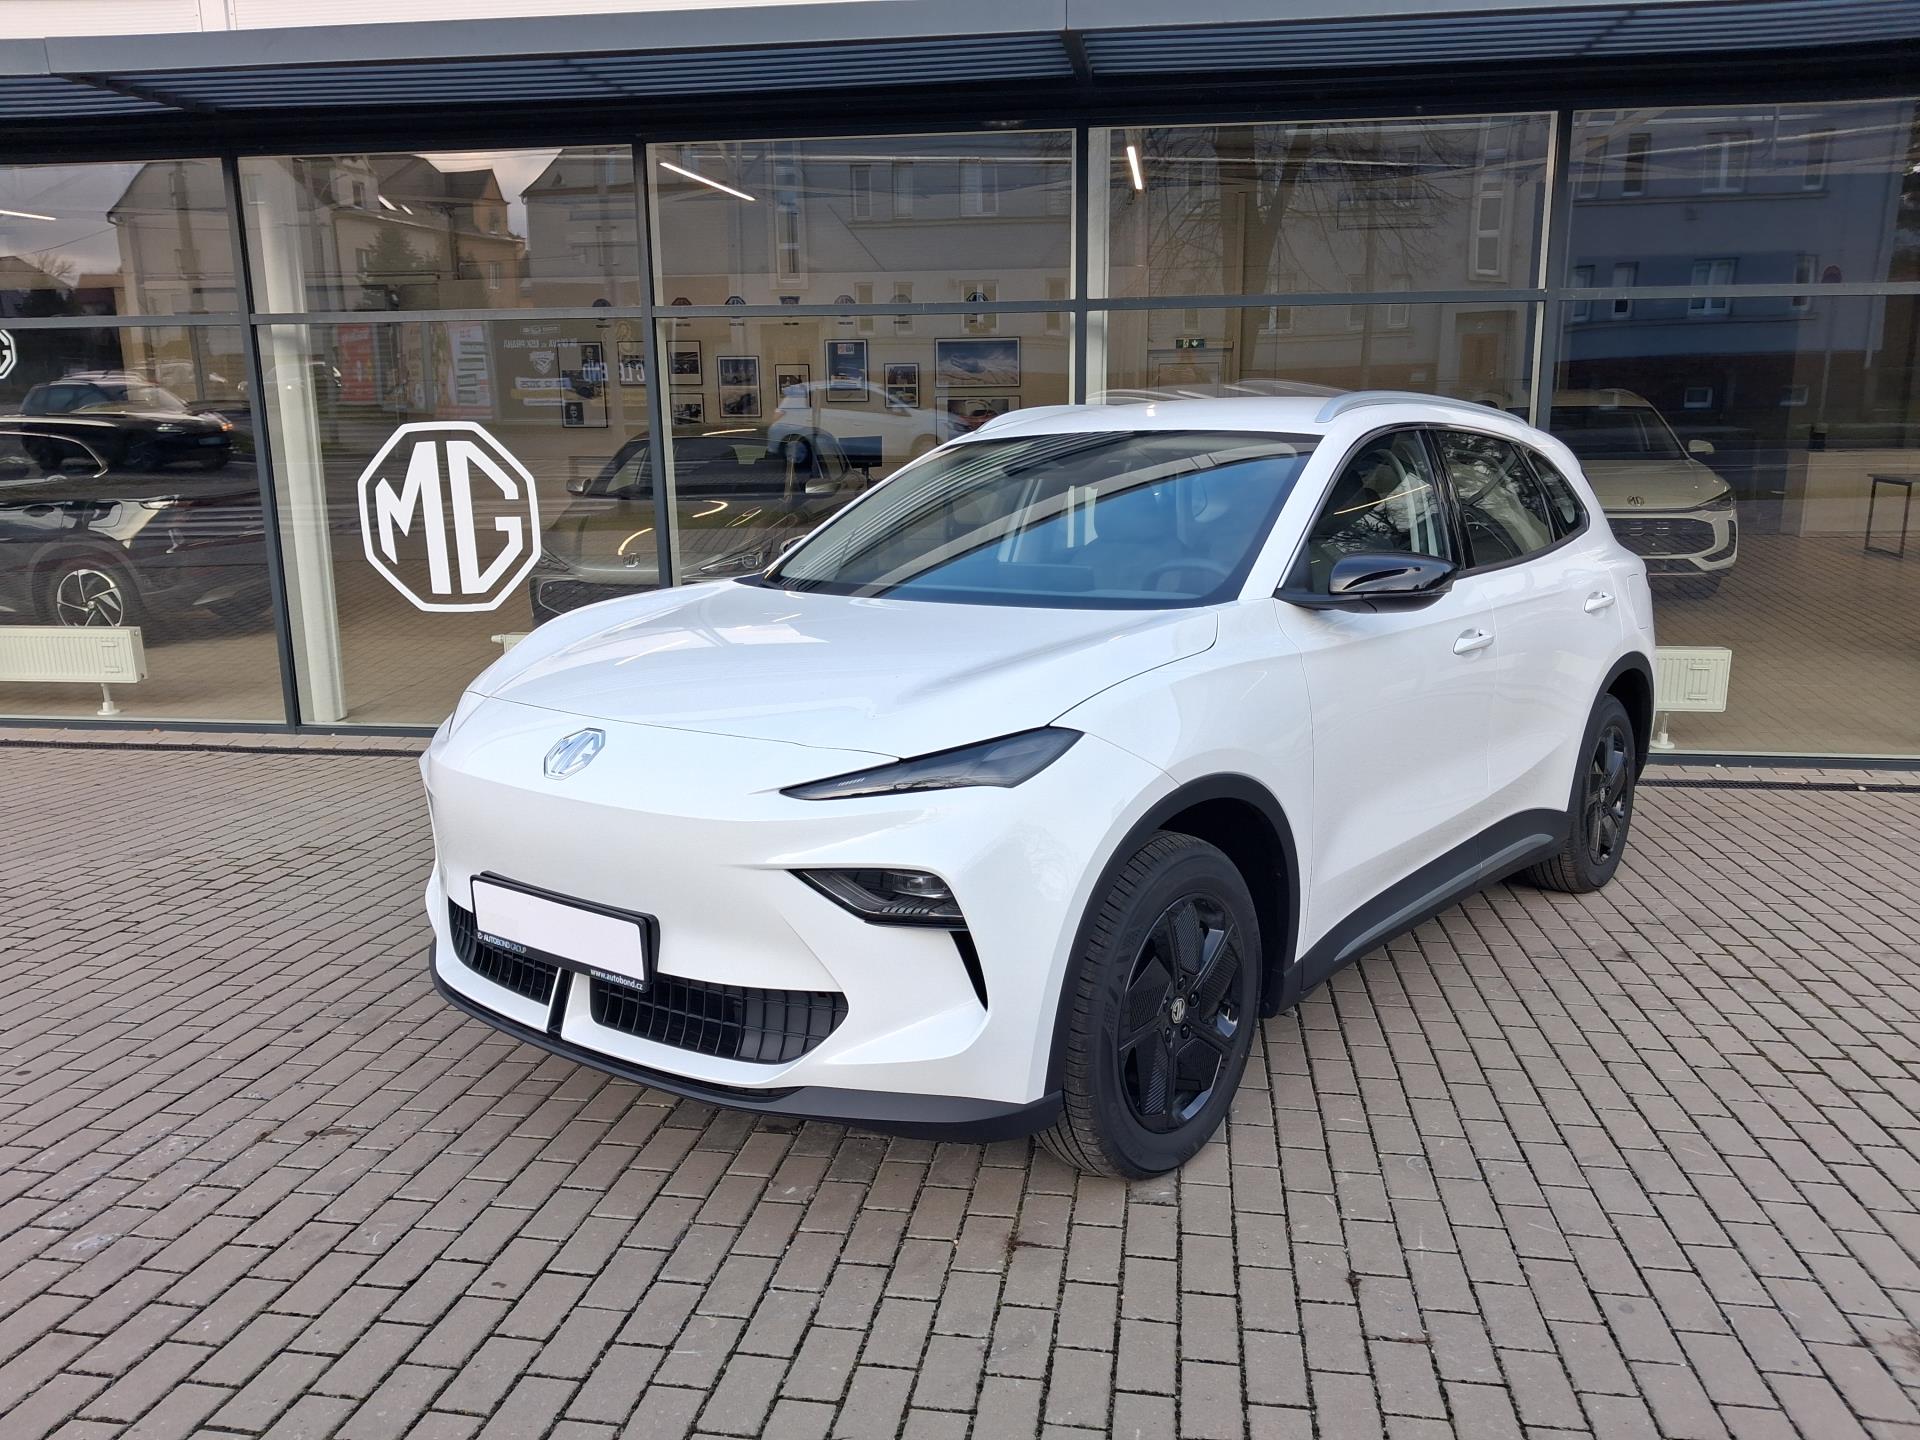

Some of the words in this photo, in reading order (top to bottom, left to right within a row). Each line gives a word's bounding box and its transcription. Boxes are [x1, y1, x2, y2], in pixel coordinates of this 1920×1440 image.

[374, 440, 524, 595] MG
[546, 730, 602, 777] MG
[590, 969, 643, 990] www.autobond.cz
